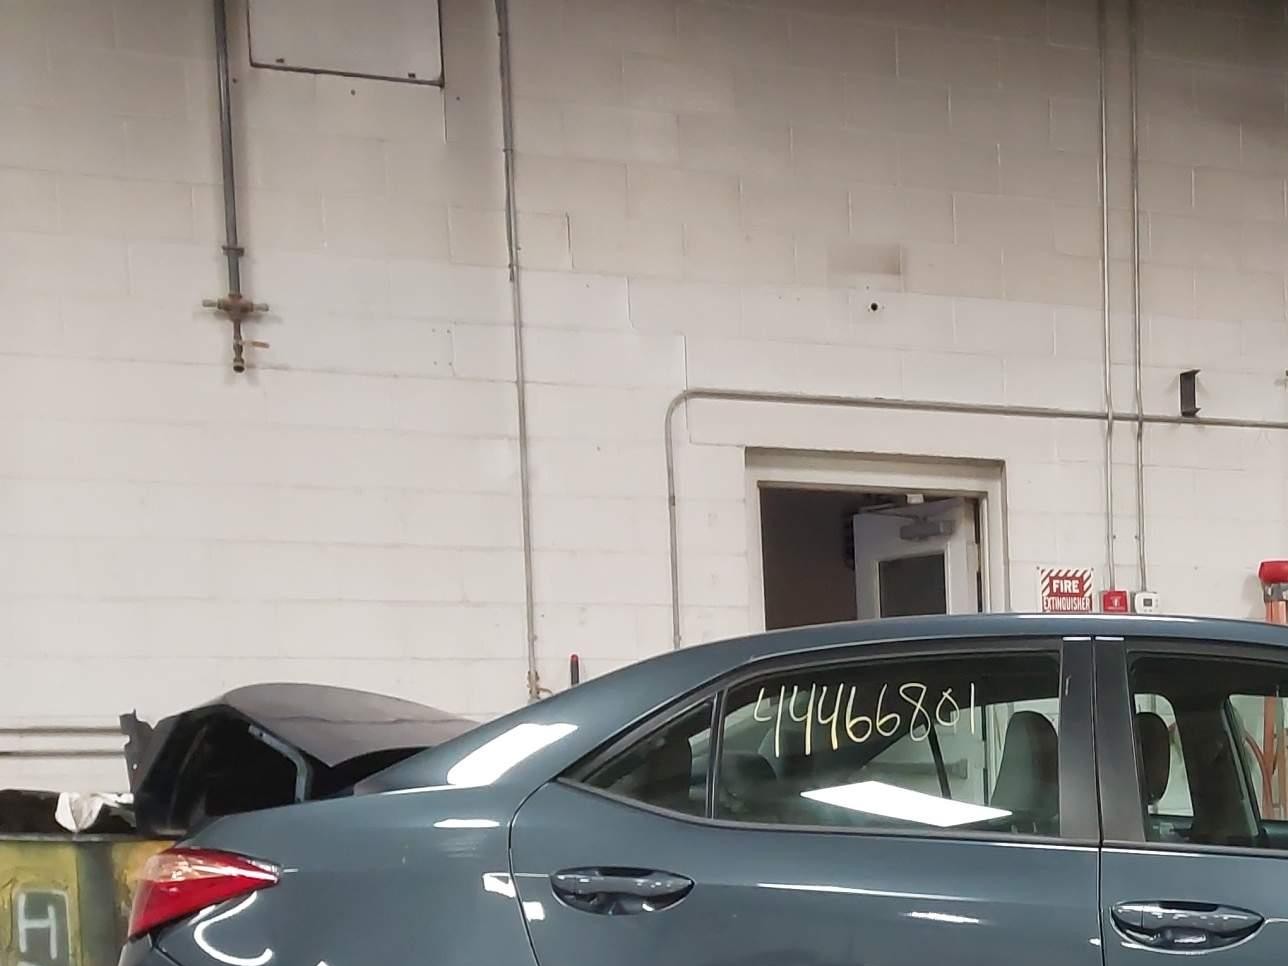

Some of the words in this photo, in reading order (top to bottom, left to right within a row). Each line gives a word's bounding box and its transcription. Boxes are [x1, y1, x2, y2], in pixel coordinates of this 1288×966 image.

[1052, 579, 1080, 593] FIRE
[1043, 596, 1091, 611] EXTINGUISHER
[753, 681, 976, 758] 44466801
